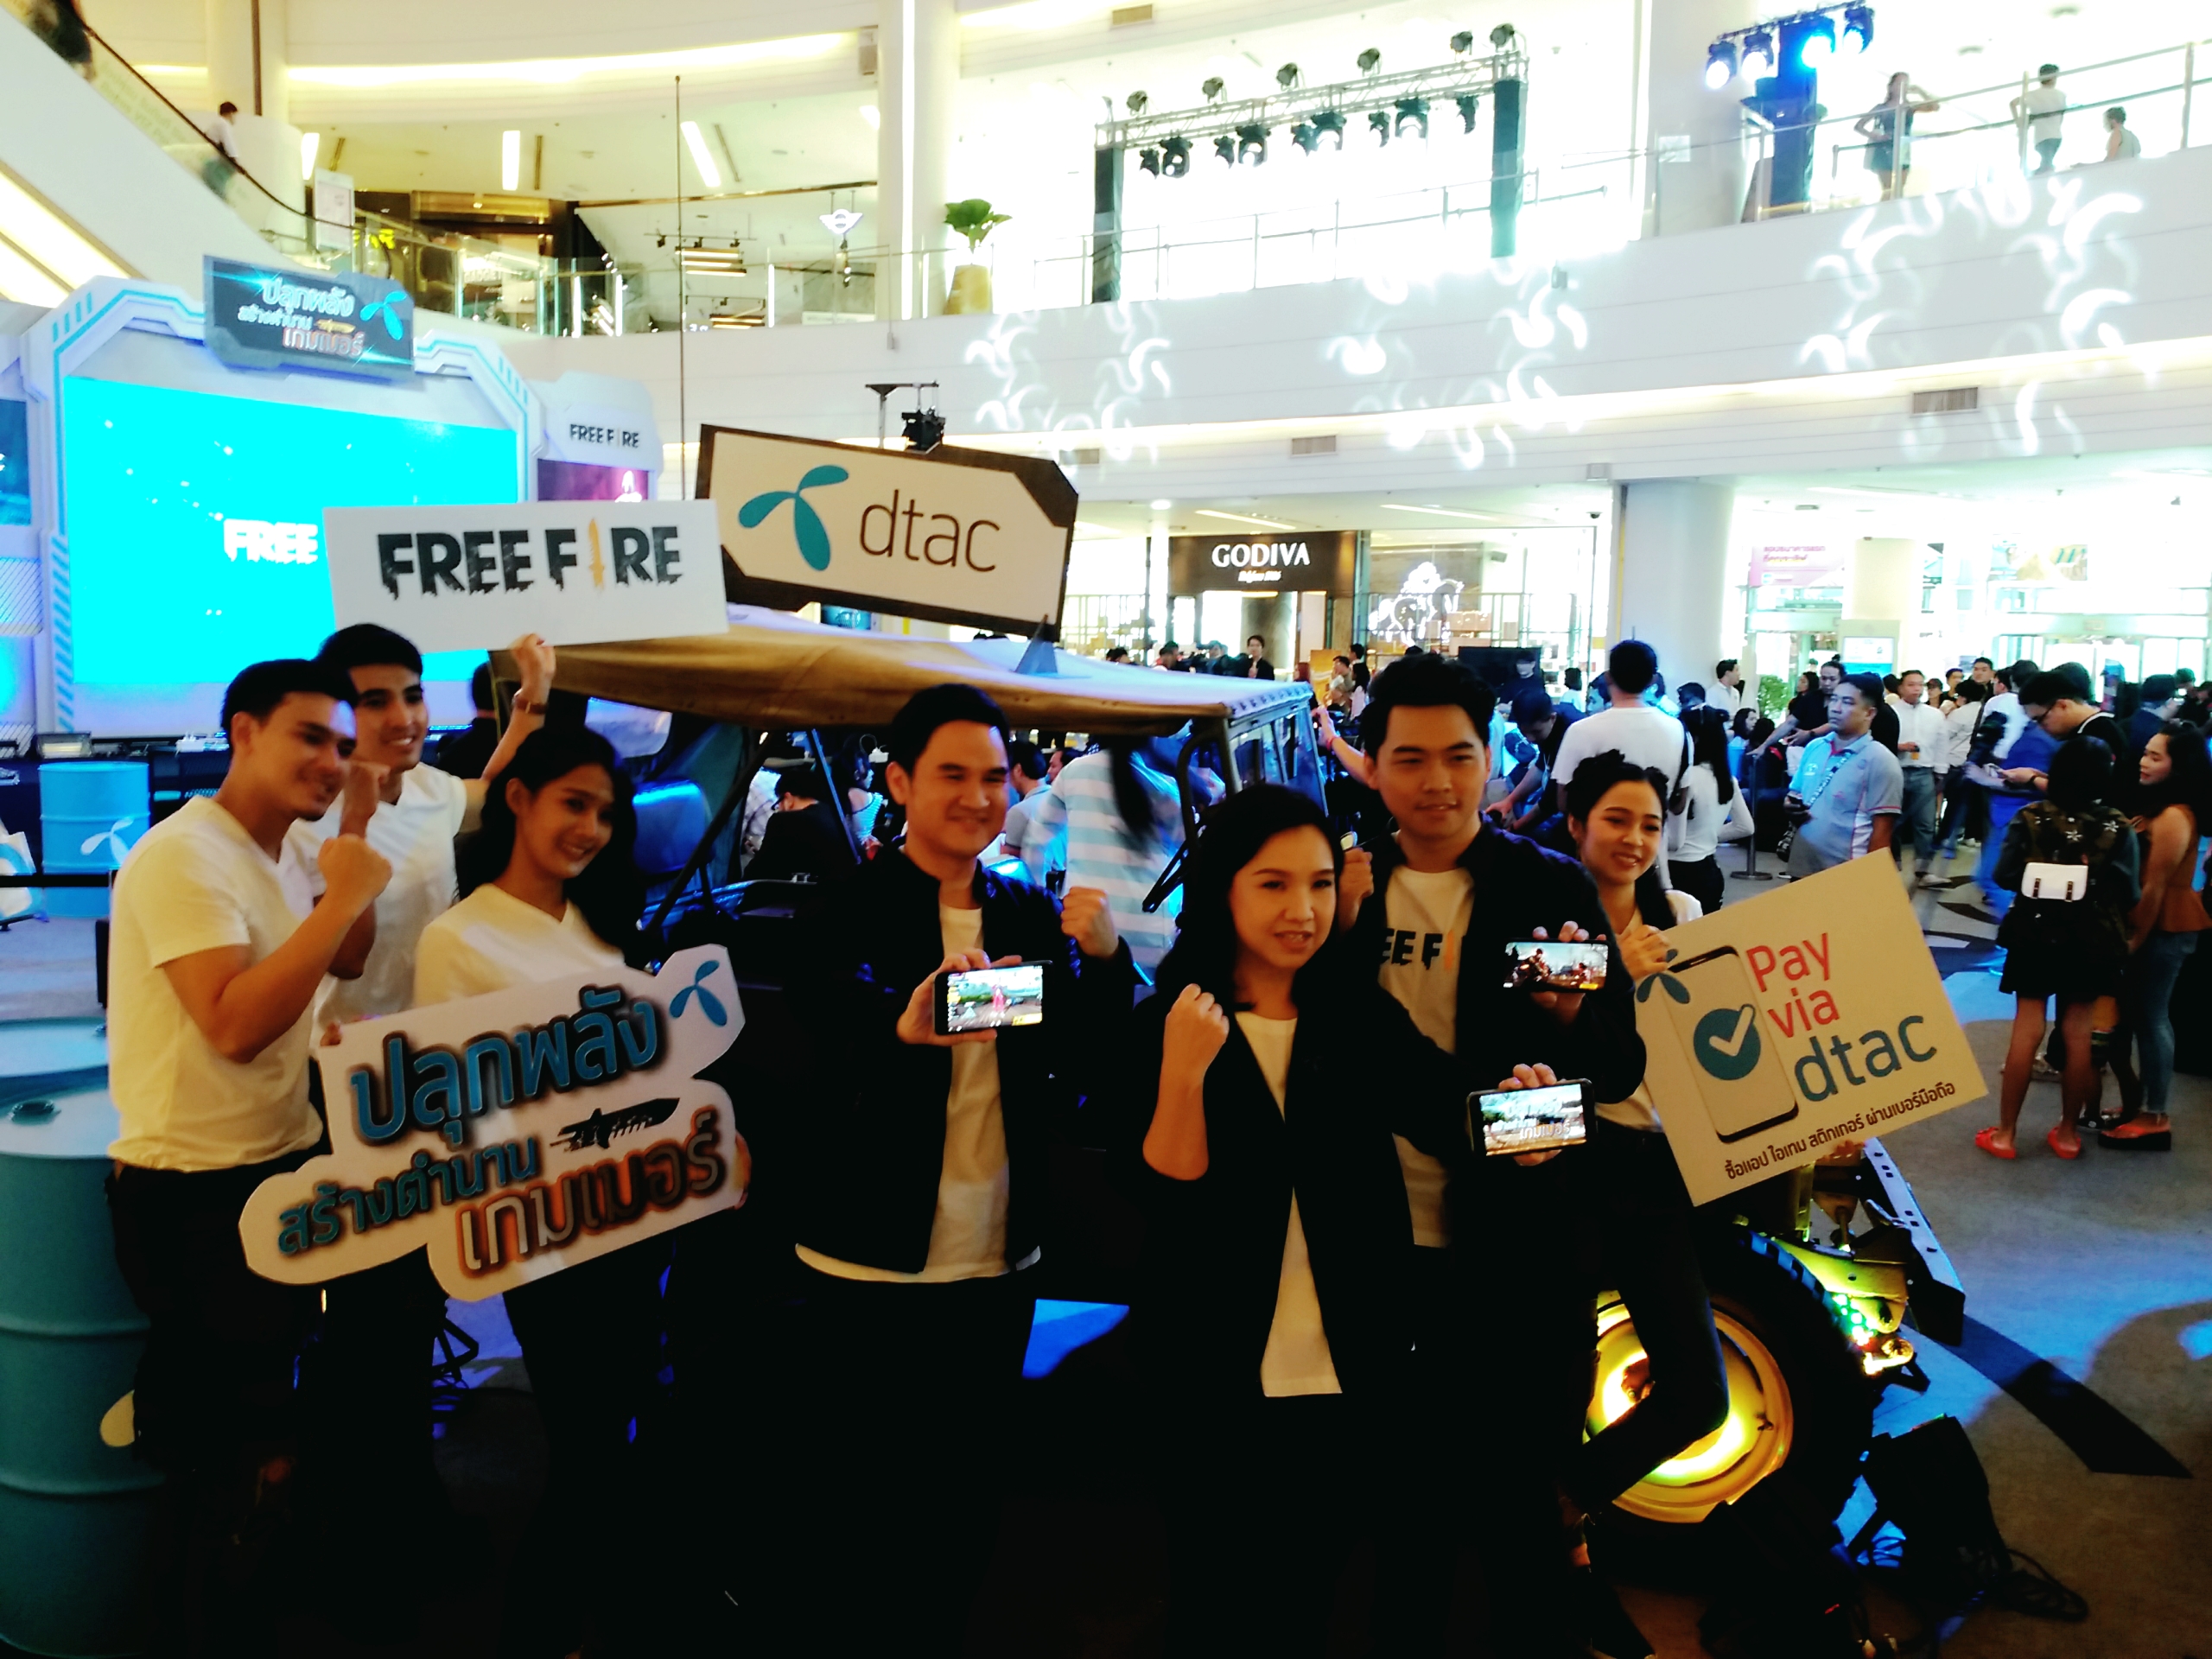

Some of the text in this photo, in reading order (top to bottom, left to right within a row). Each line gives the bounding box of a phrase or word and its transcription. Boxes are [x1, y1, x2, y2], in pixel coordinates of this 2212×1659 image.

[569, 423, 604, 443] FREE
[223, 518, 319, 565] FREE
[377, 529, 535, 601] FREE
[859, 488, 1001, 574] dtac
[1211, 542, 1311, 568] GODIVA
[1745, 932, 1831, 992] Pay
[1767, 987, 1840, 1039] via
[348, 987, 662, 1147] ปลุกพลัง
[1794, 1015, 1938, 1103] dtac
[1725, 1149, 1770, 1179] ซื้อแอป
[1768, 1138, 1808, 1163] ไอเทม
[1866, 1081, 1956, 1125] ผ่านเบอร์มือถือ
[276, 1134, 540, 1257] สร้างตำนาน
[454, 1103, 728, 1281] เกมเมอร์
